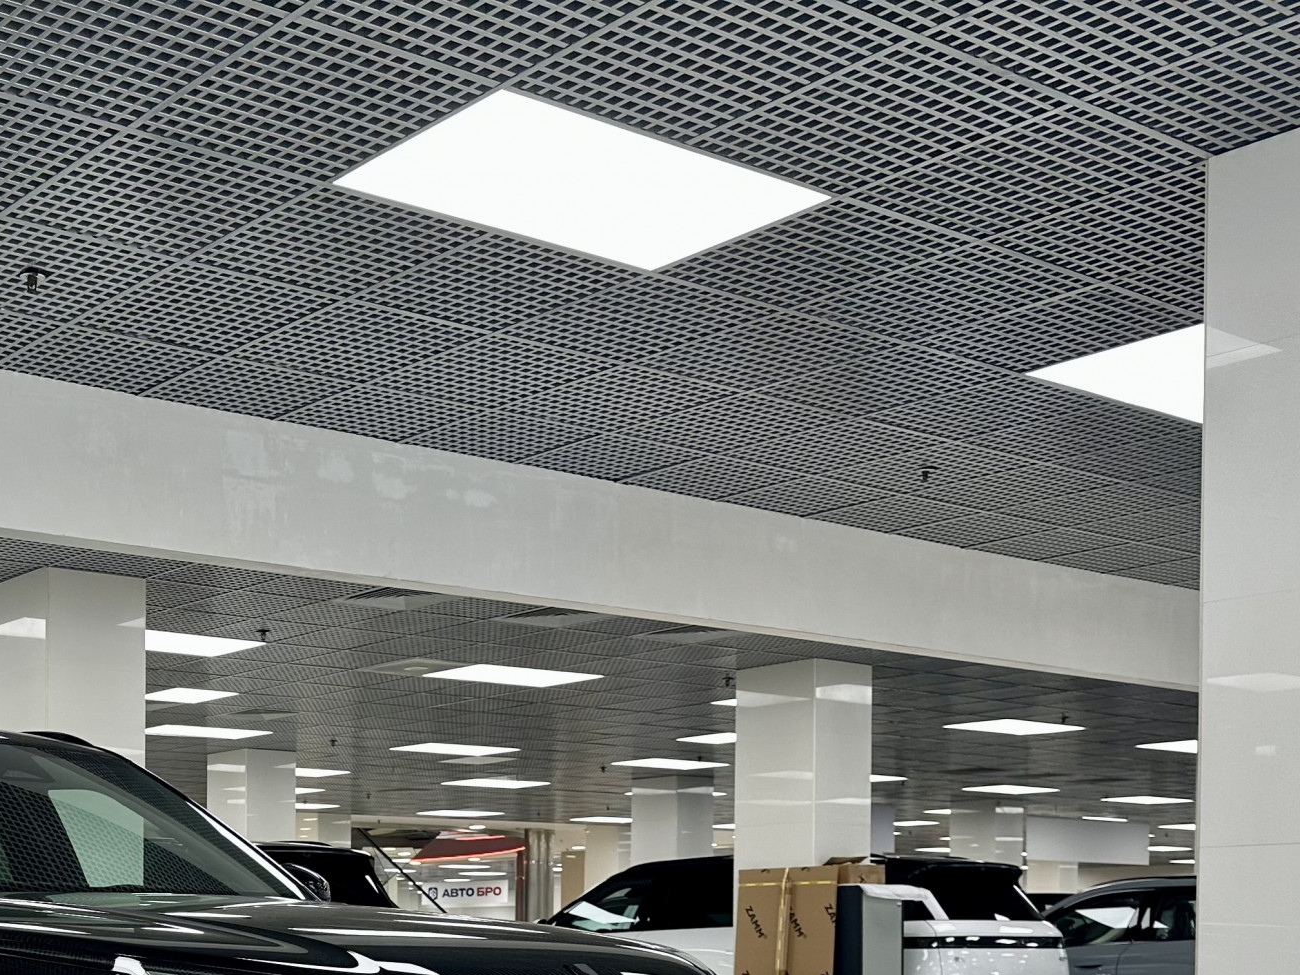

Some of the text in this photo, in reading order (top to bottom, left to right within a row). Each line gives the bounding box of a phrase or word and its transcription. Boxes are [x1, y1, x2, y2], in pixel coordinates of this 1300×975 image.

[442, 886, 502, 898] АВТО БРО
[745, 905, 765, 939] ZAMM
[789, 908, 805, 938] AMM
